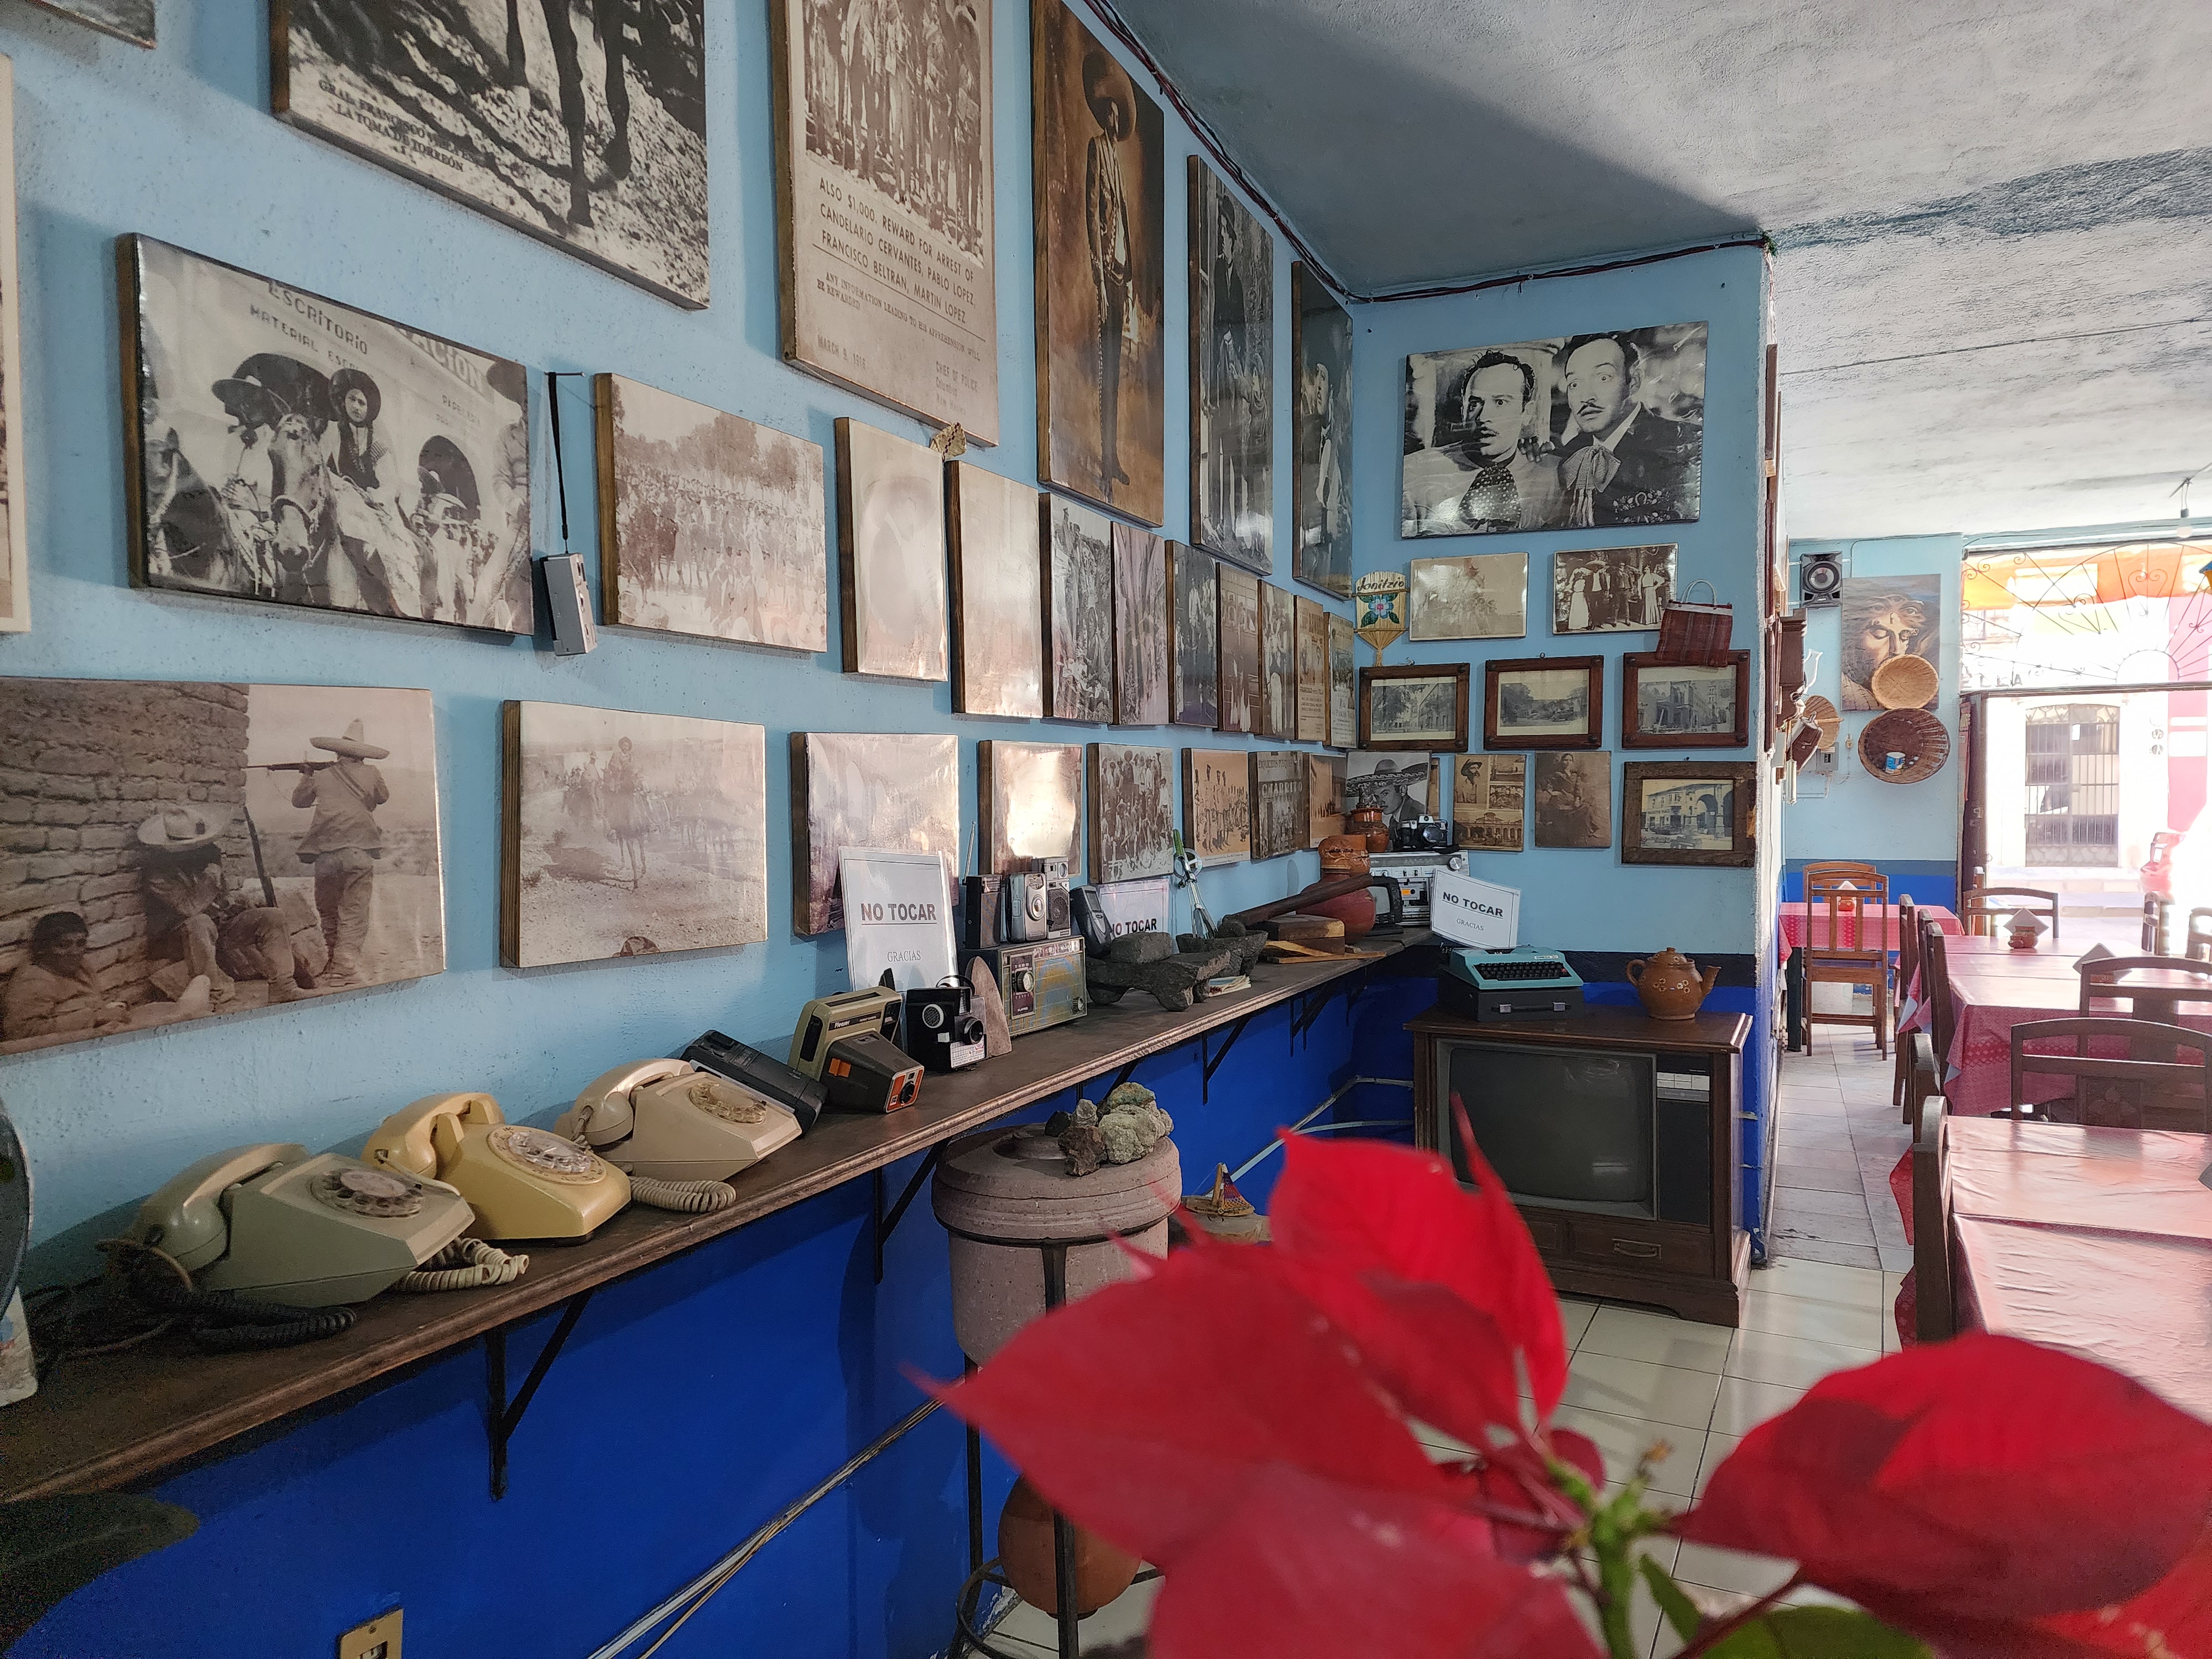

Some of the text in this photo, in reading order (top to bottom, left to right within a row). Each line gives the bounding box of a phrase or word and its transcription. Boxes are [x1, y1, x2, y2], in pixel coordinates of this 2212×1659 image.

[820, 176, 842, 201] ALSO
[882, 215, 915, 246] REWARD
[919, 237, 933, 259] FOR
[936, 251, 961, 276] ARREST
[964, 268, 974, 283] OF
[820, 202, 874, 246] CANDELARIO
[878, 238, 924, 277] CERVANTES,
[927, 266, 950, 290] PABLO
[822, 229, 966, 324] FRANCISCO BELTRAN, MARTIN LOPEZ
[826, 284, 860, 310] REWARDED
[826, 272, 839, 286] ANY
[841, 276, 882, 308] INFORMATION
[884, 301, 908, 322] LEADING
[909, 315, 917, 327] TO
[967, 347, 980, 362] WILL
[817, 334, 839, 357] MARCH
[860, 902, 937, 921] NO TOCAR
[1443, 891, 1503, 917] NO TOCAR
[1125, 918, 1157, 934] TOCAR
[1456, 918, 1484, 931] GRACIAS
[887, 950, 921, 962] GRACIAS
